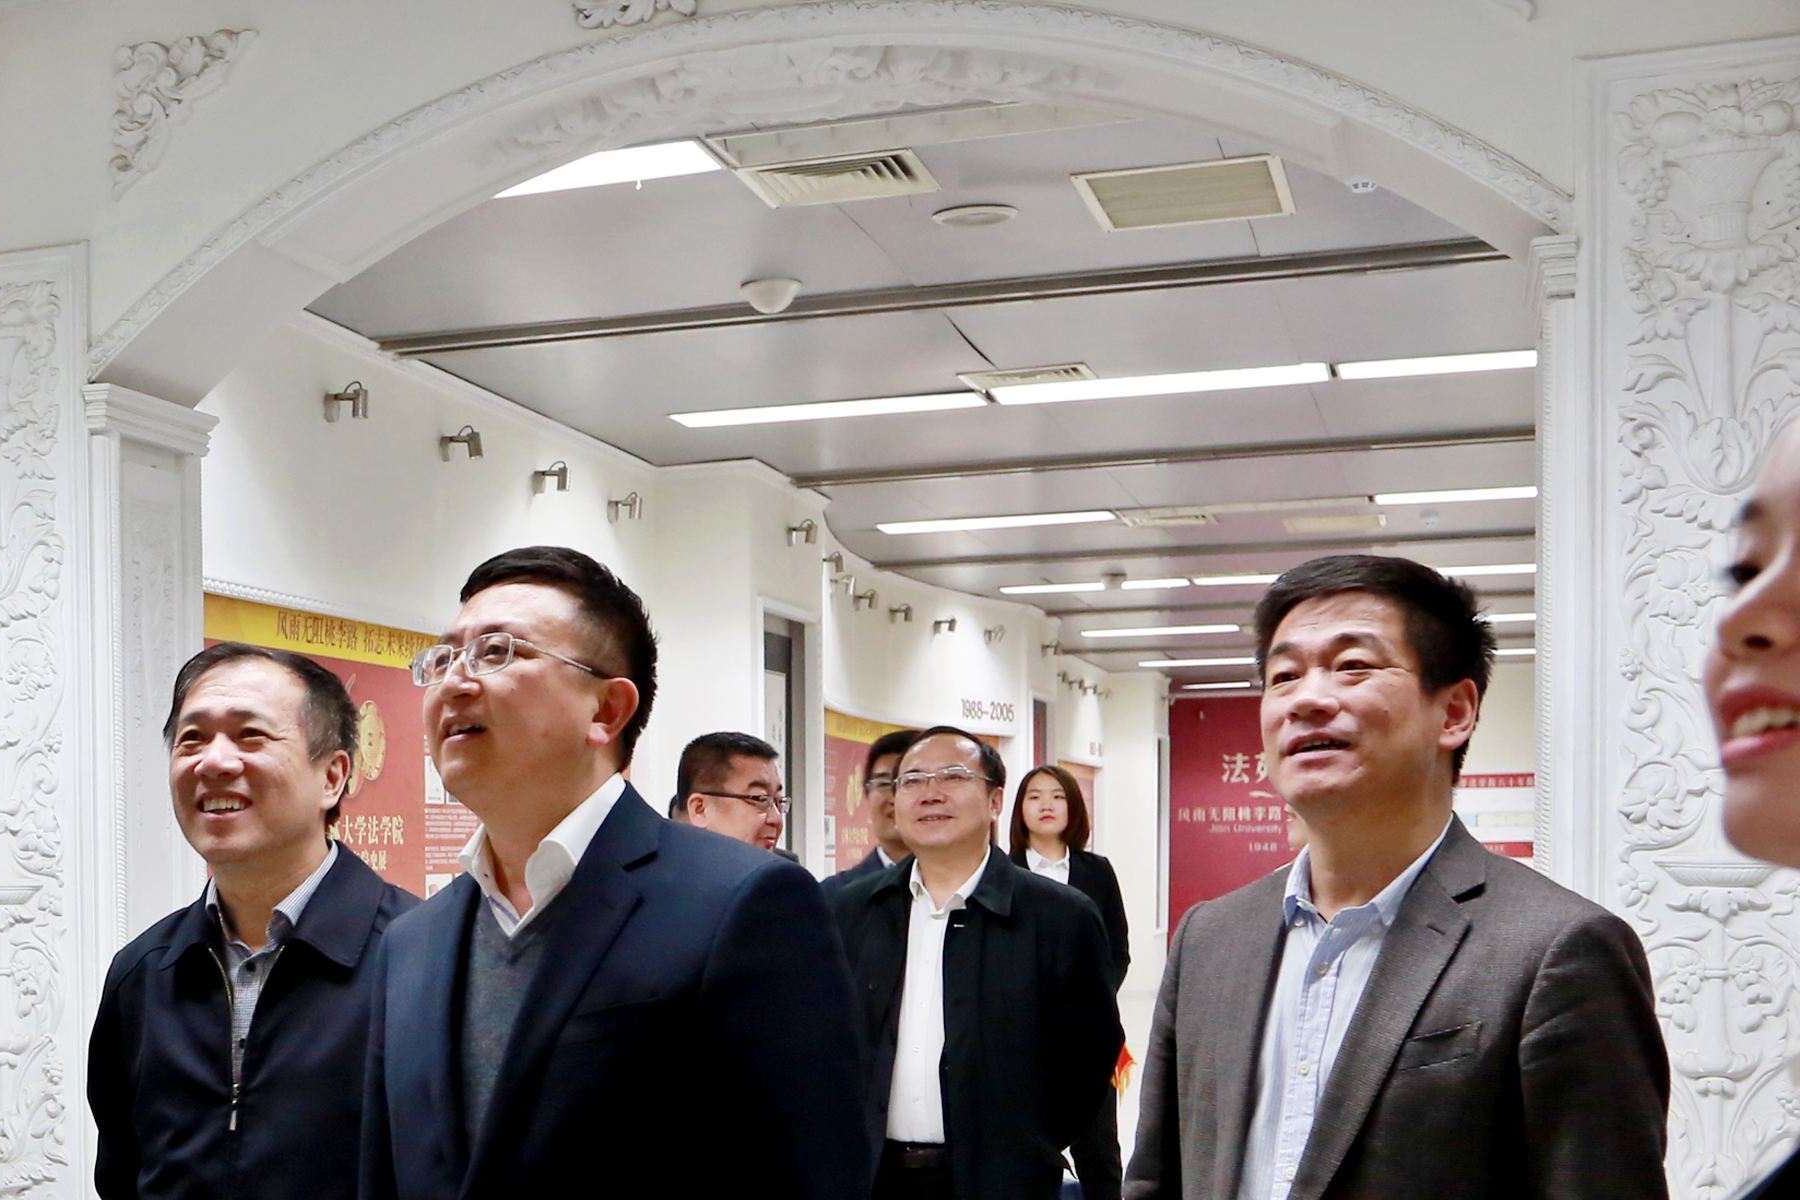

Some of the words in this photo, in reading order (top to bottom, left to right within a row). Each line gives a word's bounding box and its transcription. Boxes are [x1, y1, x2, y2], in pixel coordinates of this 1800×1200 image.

[276, 610, 358, 652] 风雨无阻桃李路
